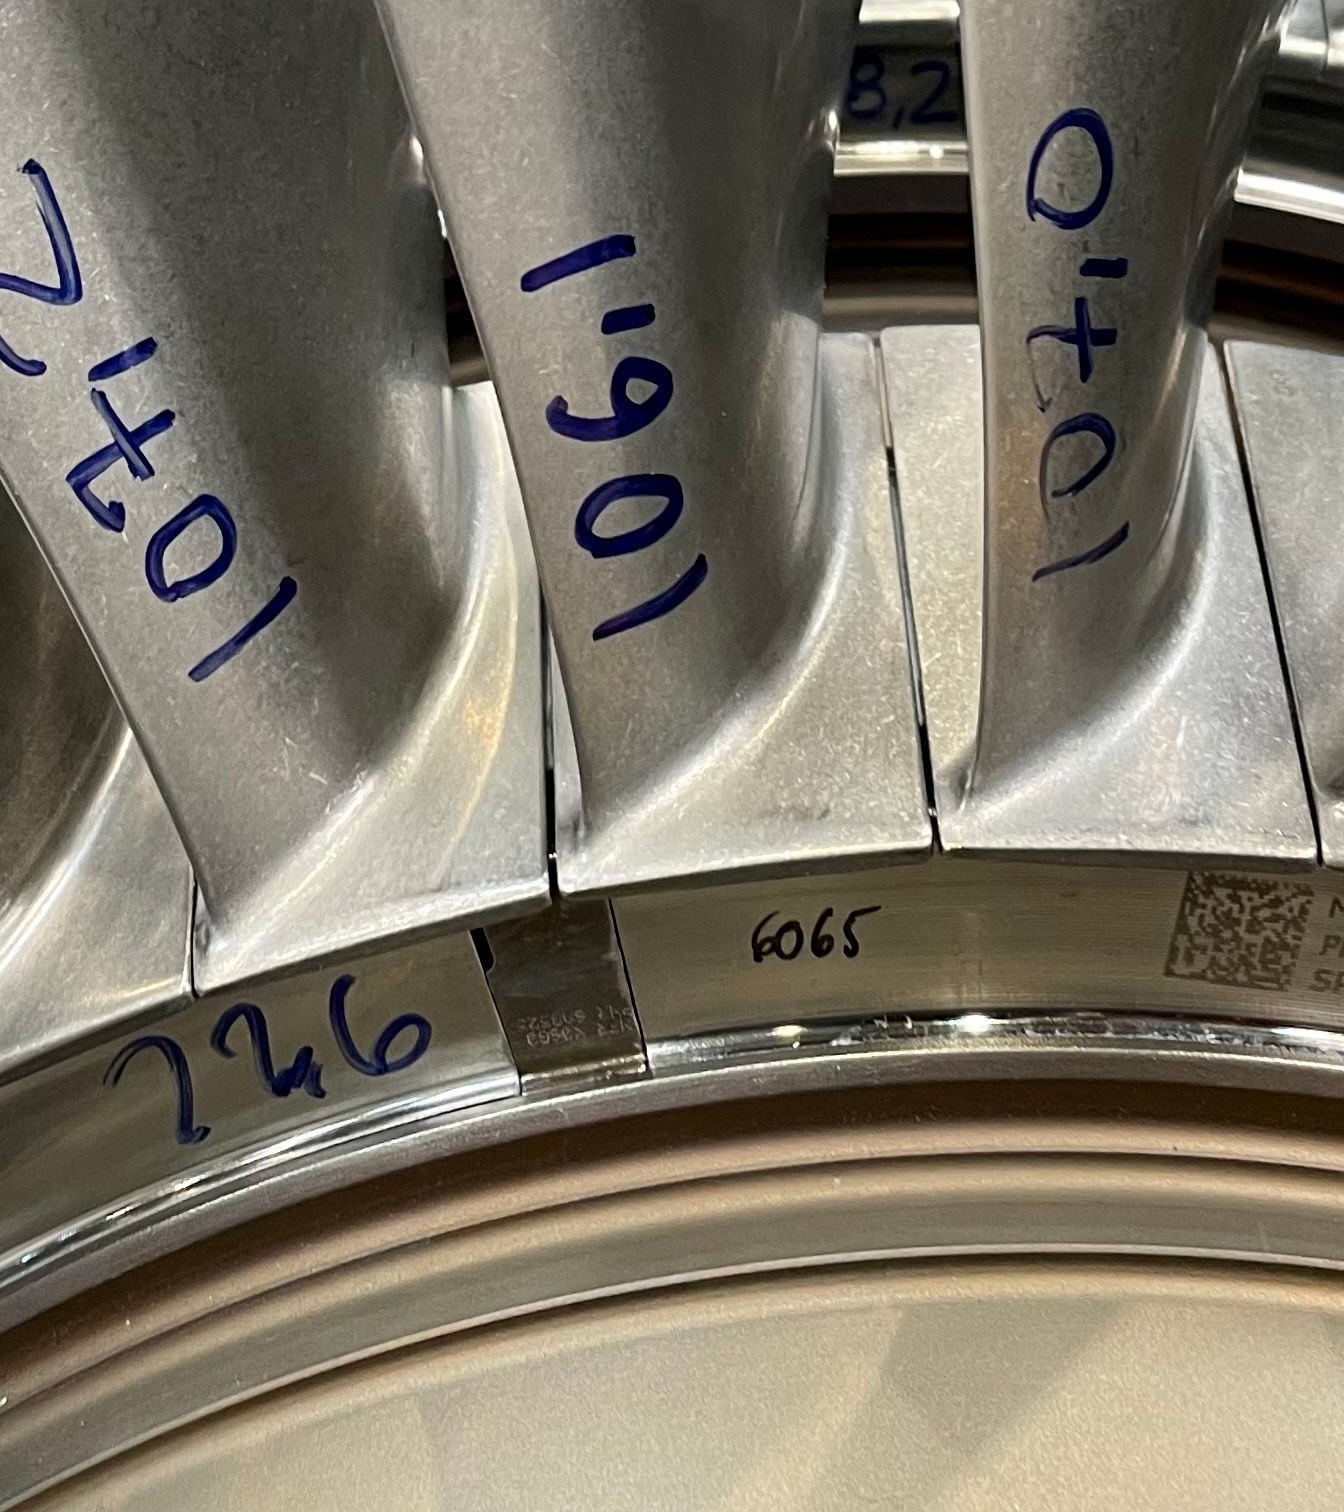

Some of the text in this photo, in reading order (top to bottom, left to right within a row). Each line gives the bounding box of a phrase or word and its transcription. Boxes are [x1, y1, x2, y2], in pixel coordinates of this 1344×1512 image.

[520, 234, 709, 641] 106,1
[1027, 106, 1130, 583] 107,0
[750, 906, 881, 963] 6065
